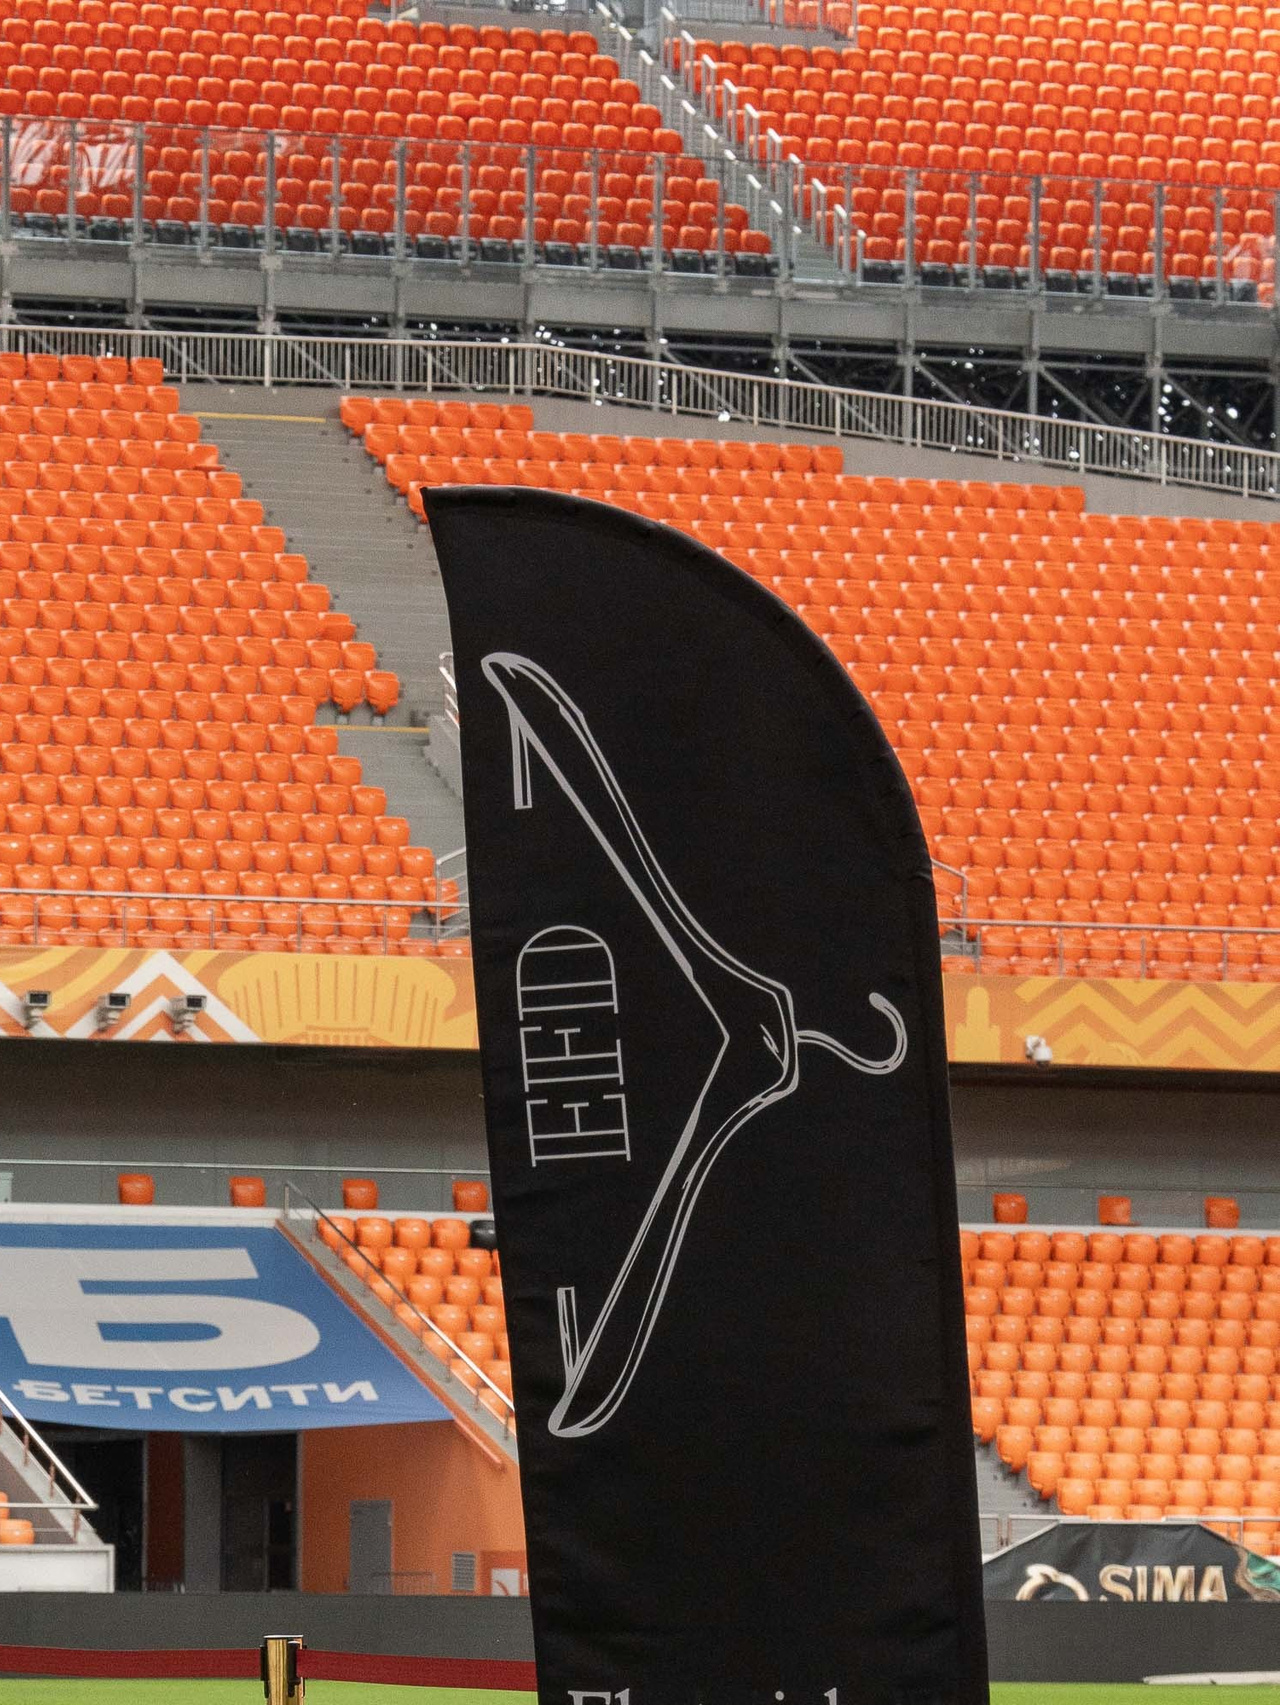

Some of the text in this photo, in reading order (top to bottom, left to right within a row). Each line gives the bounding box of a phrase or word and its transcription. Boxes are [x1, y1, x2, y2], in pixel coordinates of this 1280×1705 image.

[516, 925, 631, 1167] EFD
[13, 1379, 379, 1412] БЕТСИТИ
[1099, 1564, 1228, 1602] SIMA
